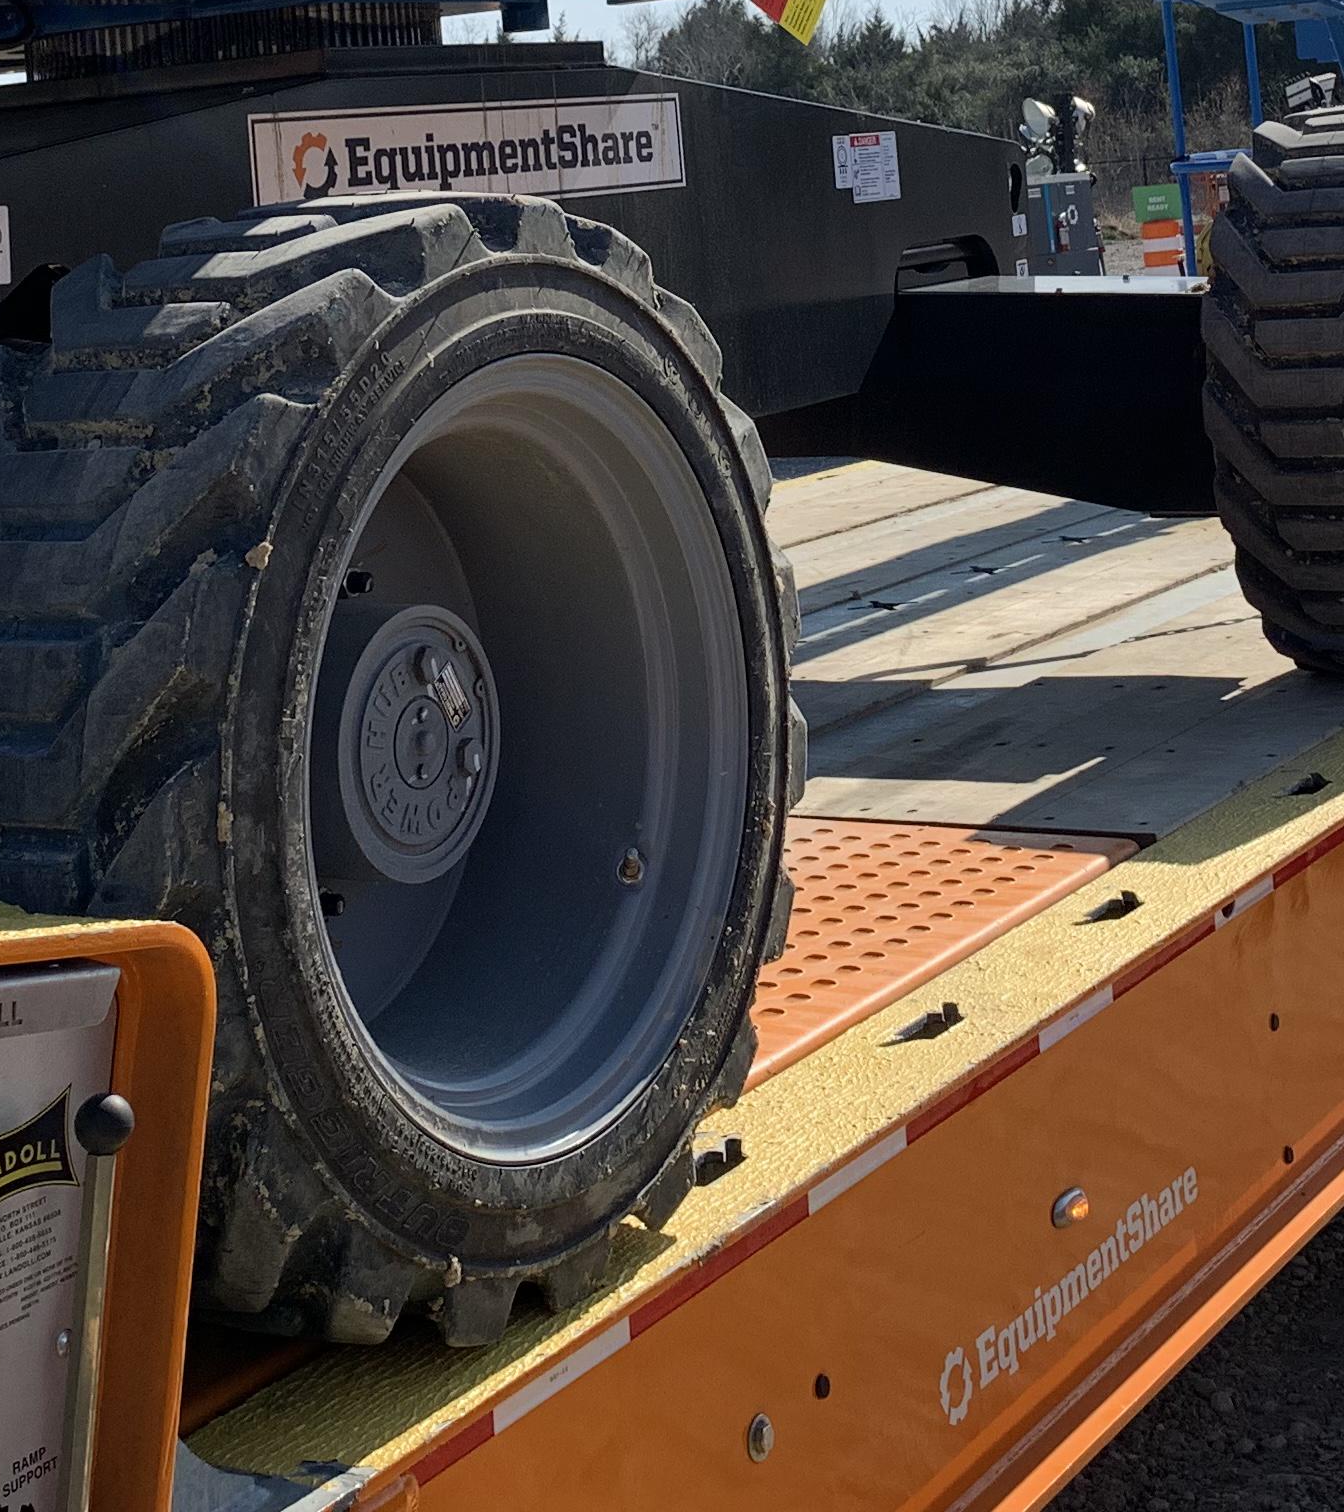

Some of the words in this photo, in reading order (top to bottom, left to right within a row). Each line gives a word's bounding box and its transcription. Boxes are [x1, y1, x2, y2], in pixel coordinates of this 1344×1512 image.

[345, 123, 653, 190] EquipmentShare
[976, 1166, 1199, 1389] EquipmentShare
[2, 1456, 58, 1498] SUPPORT
[12, 1446, 46, 1476] RAMP
